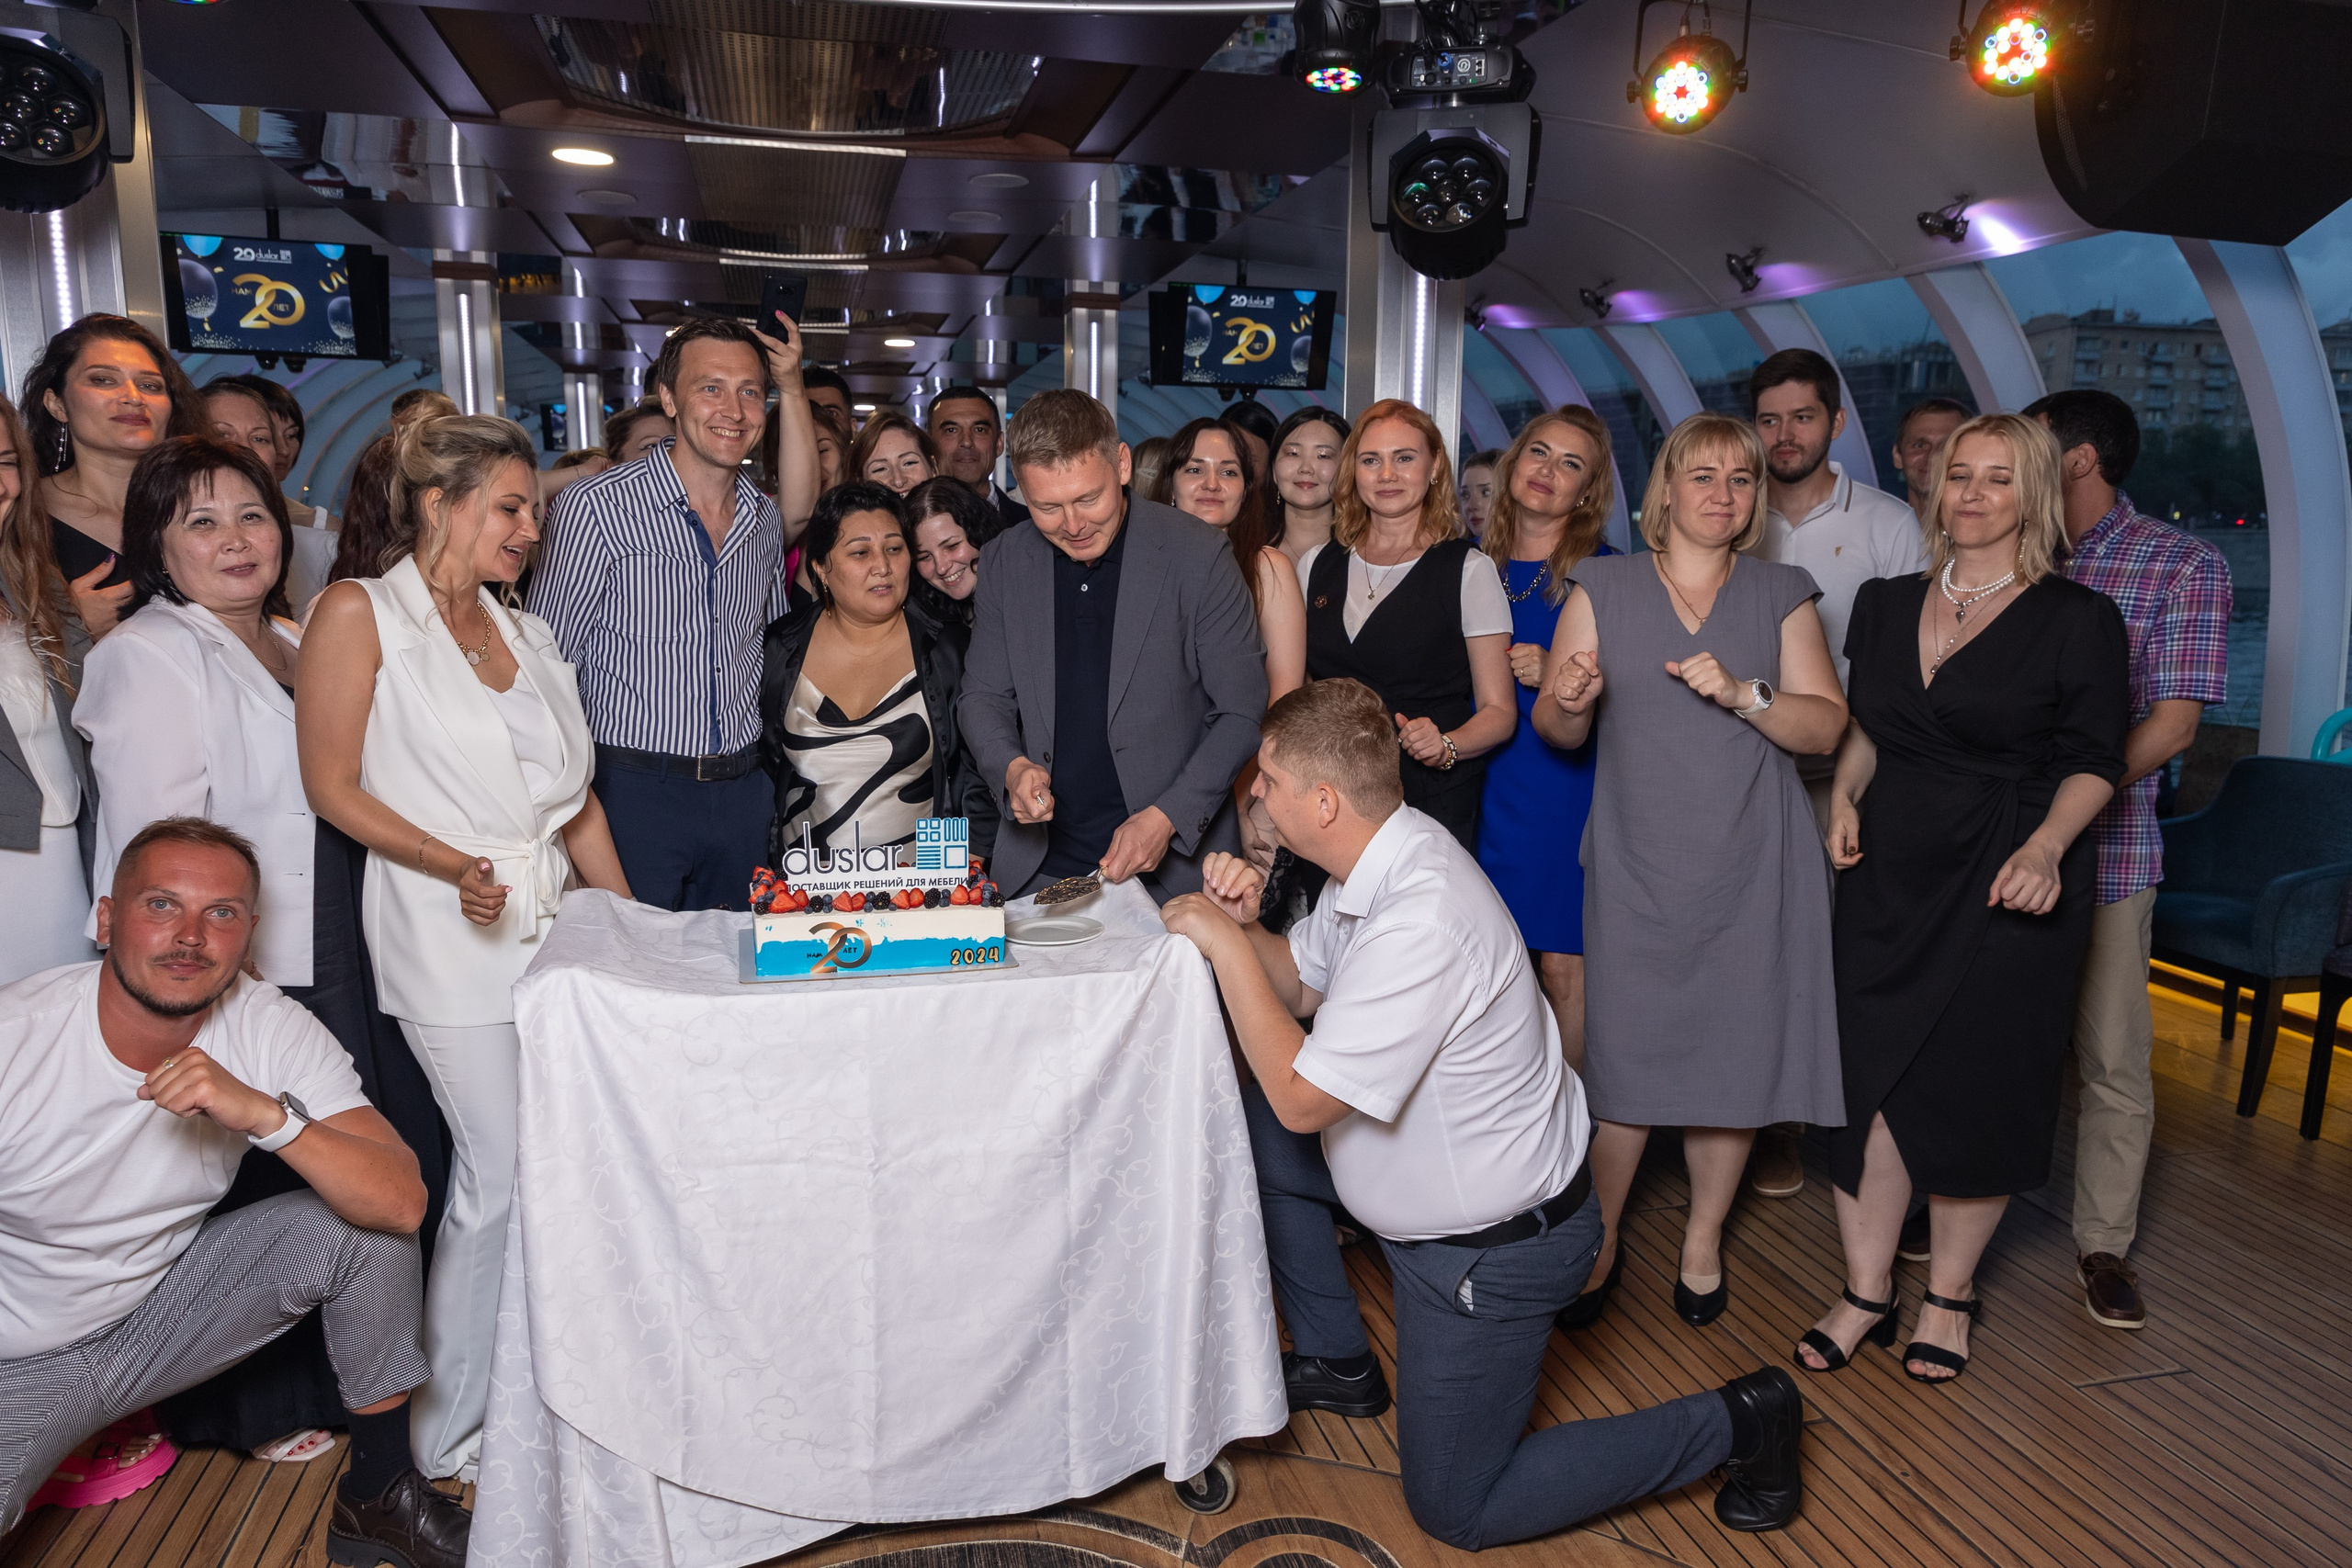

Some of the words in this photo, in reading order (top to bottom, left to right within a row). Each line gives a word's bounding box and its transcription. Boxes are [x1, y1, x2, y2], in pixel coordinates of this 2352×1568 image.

[233, 247, 255, 261] 20
[232, 273, 305, 329] 20
[1230, 294, 1248, 307] 20
[1222, 317, 1276, 365] 20
[784, 820, 902, 874] duslar
[854, 877, 903, 889] РЕШЕНИЙ
[906, 878, 926, 887] ДЛЯ
[928, 876, 967, 886] МЕБЕЛИ
[808, 921, 872, 974] 20
[950, 946, 1000, 965] 2024
